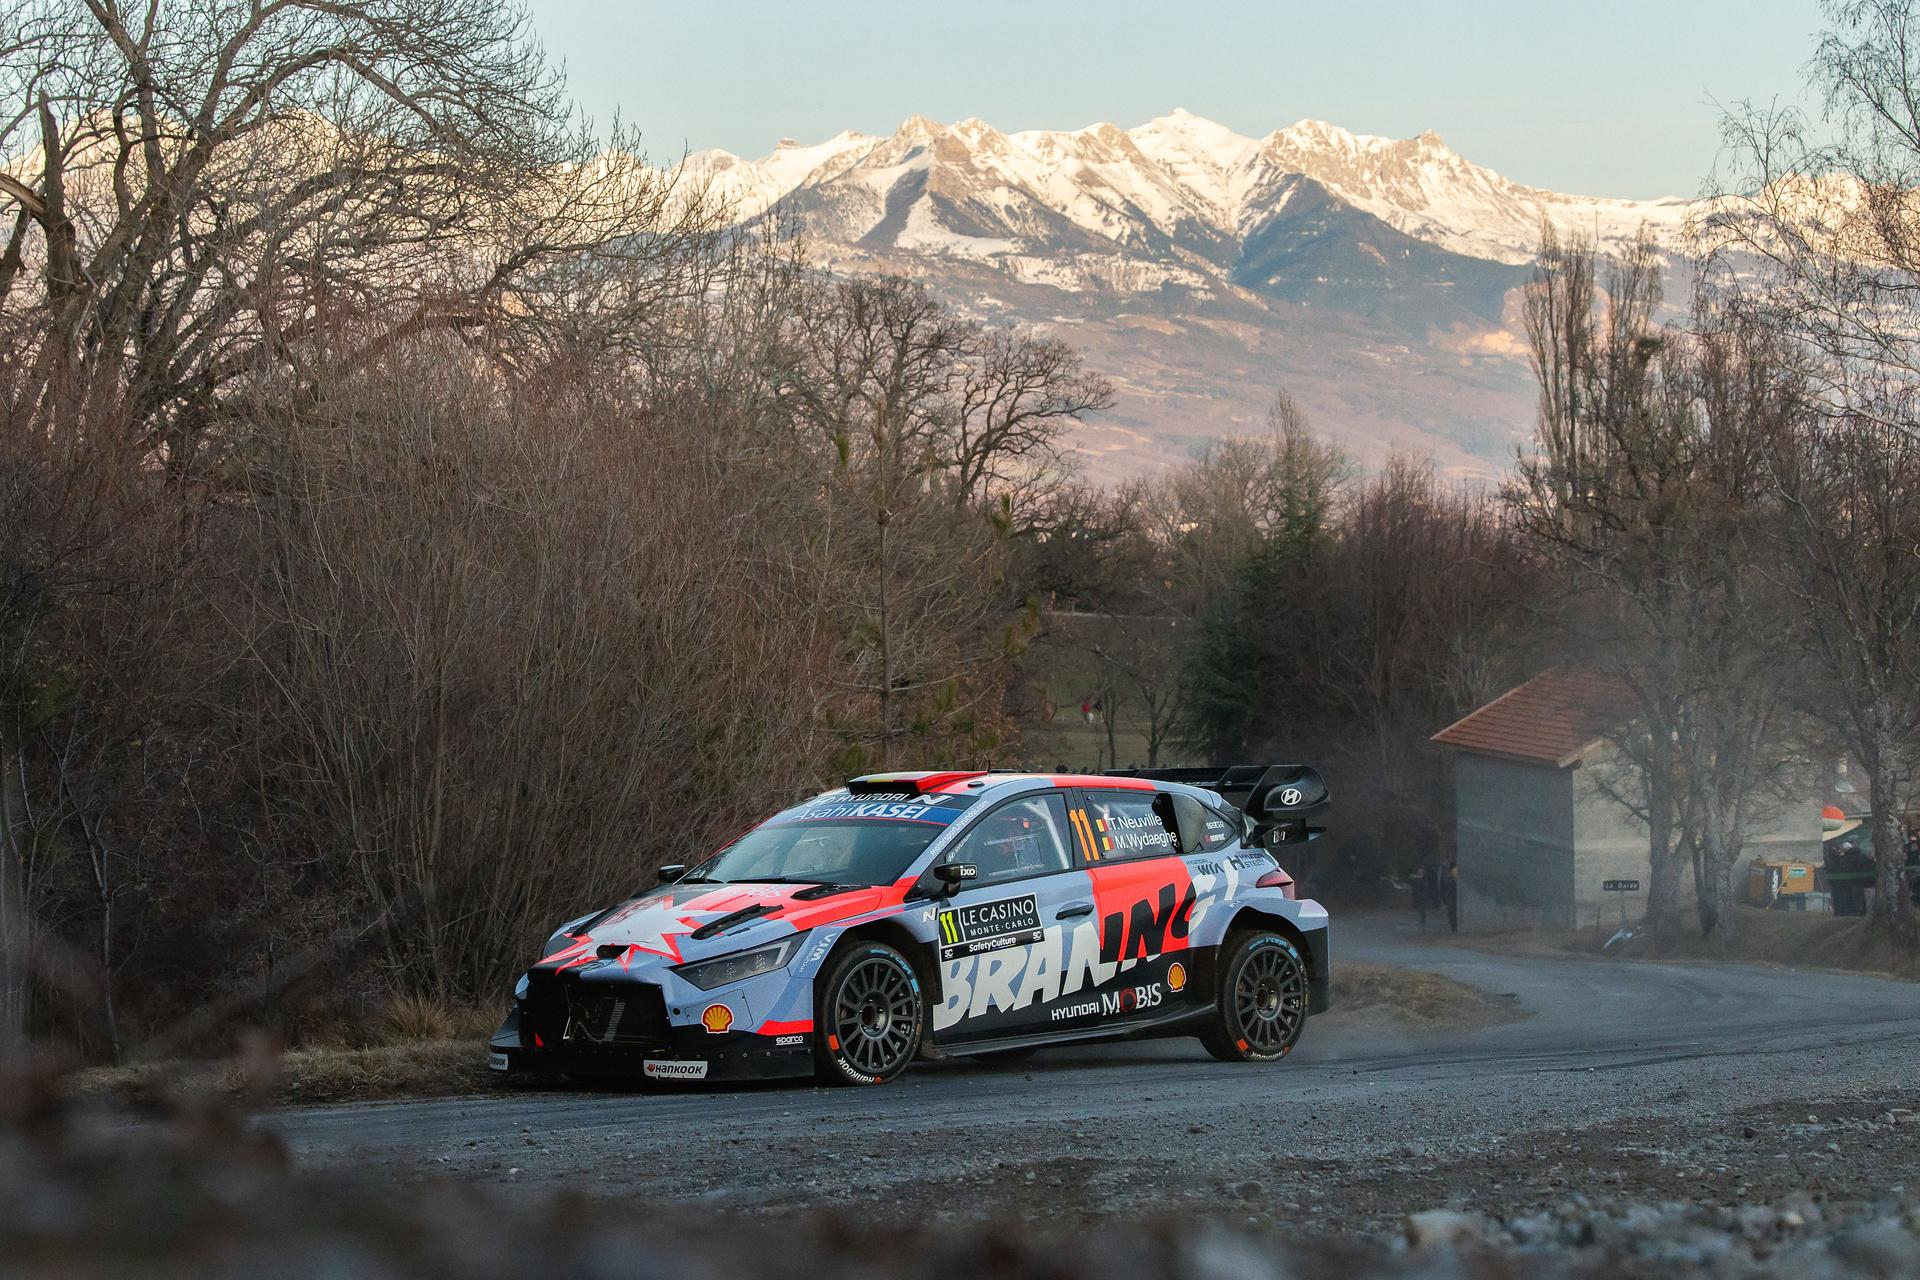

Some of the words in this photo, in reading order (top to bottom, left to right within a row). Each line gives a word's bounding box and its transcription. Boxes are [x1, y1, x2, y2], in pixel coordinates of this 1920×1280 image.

[837, 793, 910, 803] HYUNDAI
[930, 799, 990, 857] motorsport.hyundai.com
[1068, 808, 1100, 861] 11
[939, 911, 959, 945] 11
[962, 909, 978, 927] LE
[979, 899, 1035, 924] CASINO
[968, 936, 1017, 953] SafetyCulture
[1051, 1001, 1100, 1021] HYUNDAI
[1101, 982, 1163, 1017] MOBIS
[775, 1035, 804, 1046] sparco
